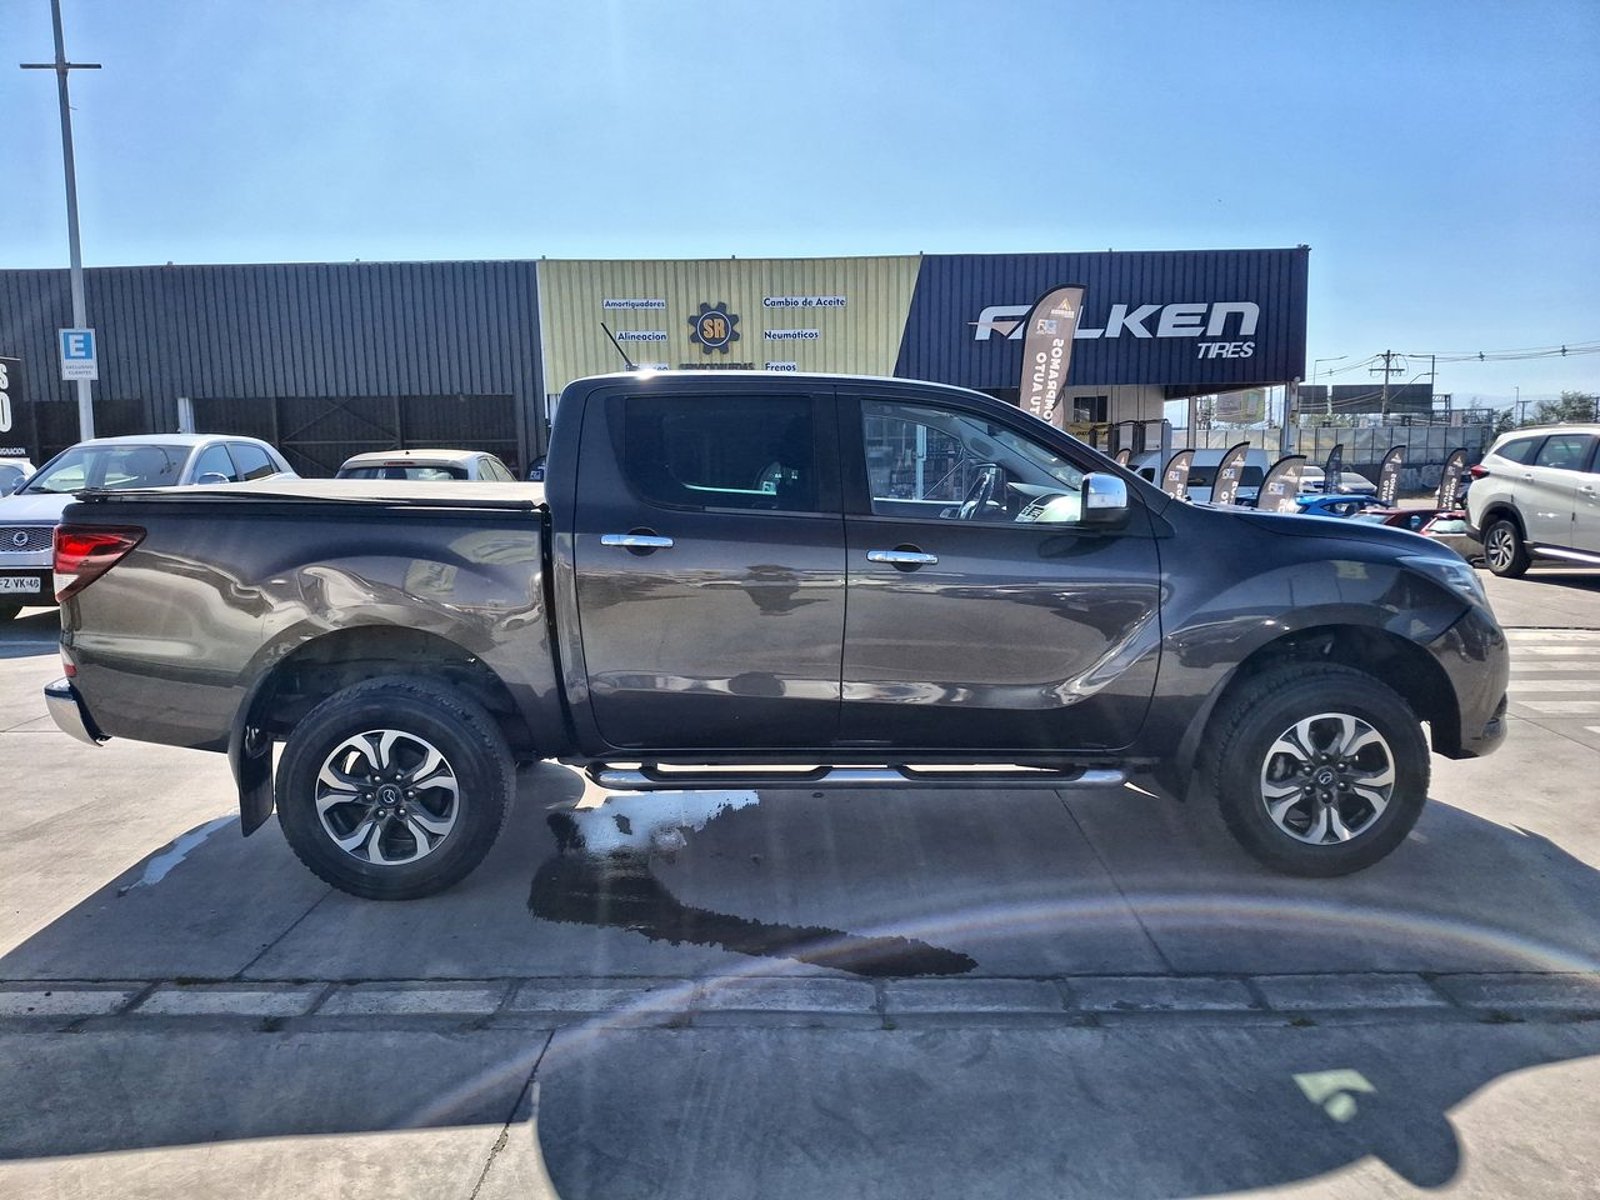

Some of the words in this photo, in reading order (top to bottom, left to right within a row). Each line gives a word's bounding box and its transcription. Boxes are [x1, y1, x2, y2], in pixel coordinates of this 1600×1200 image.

[604, 300, 665, 309] Amortiguadores
[763, 297, 800, 307] Cambio
[801, 298, 813, 307] de
[815, 297, 846, 306] Aceite
[703, 318, 726, 339] SR
[617, 331, 667, 341] Alineacion
[764, 330, 819, 340] Neumáticos
[68, 334, 86, 357] E
[1197, 341, 1256, 359] TIRES
[765, 362, 796, 372] Frenos
